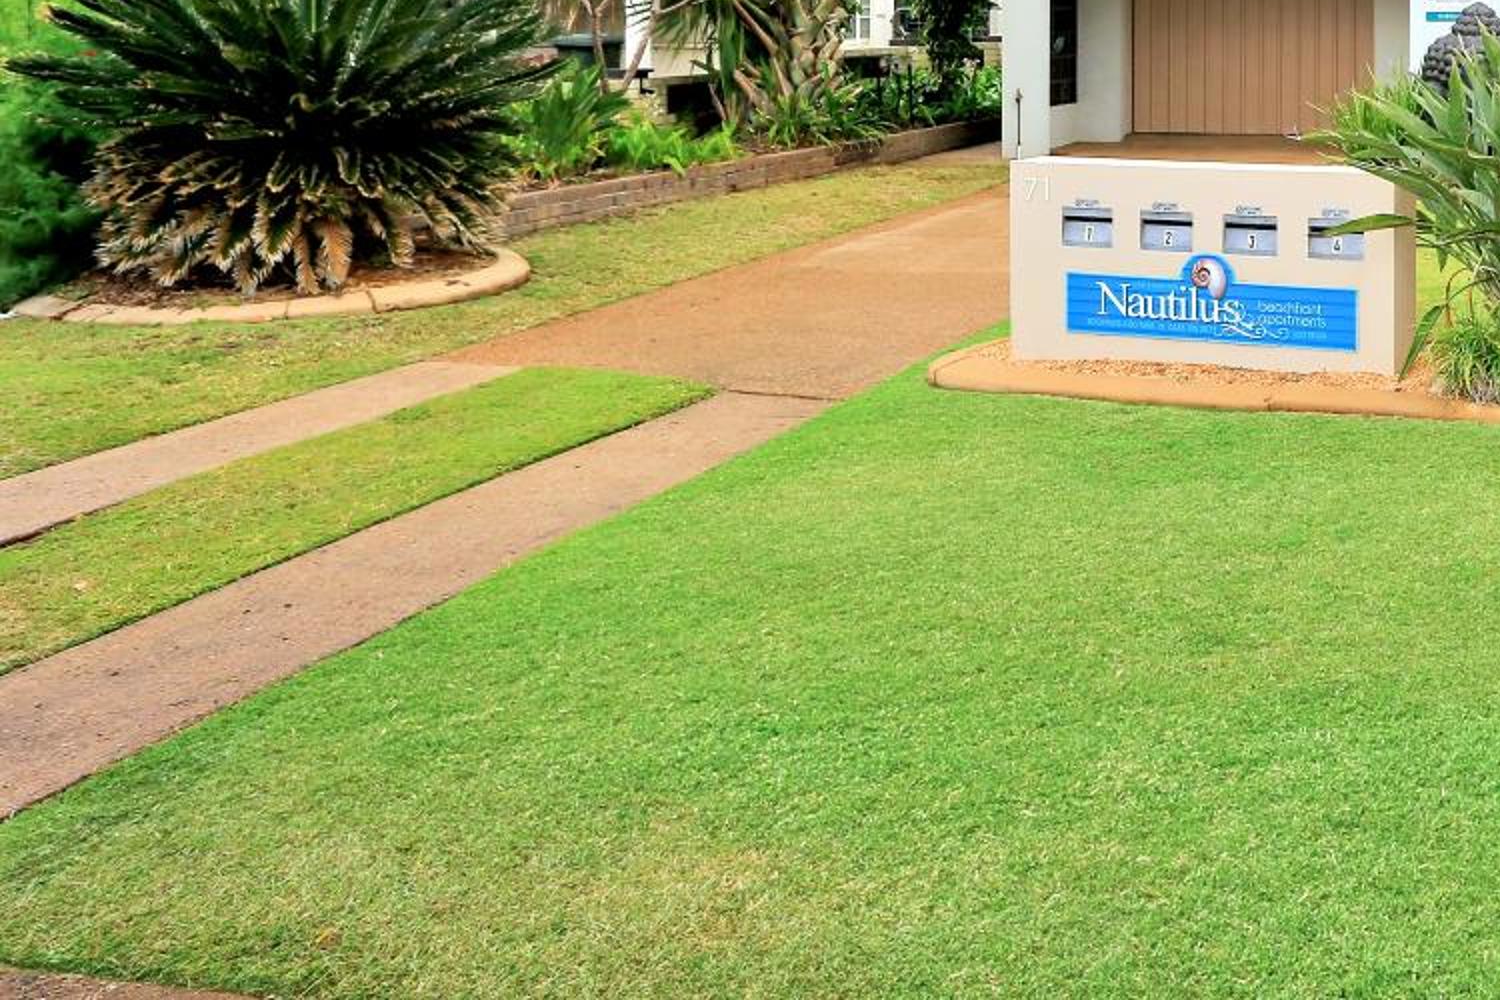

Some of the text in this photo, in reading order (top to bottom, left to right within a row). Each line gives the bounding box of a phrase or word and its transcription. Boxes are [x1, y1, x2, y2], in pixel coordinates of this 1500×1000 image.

[1023, 176, 1051, 201] 71
[1164, 231, 1173, 245] 2
[1096, 281, 1243, 324] Nautilus
